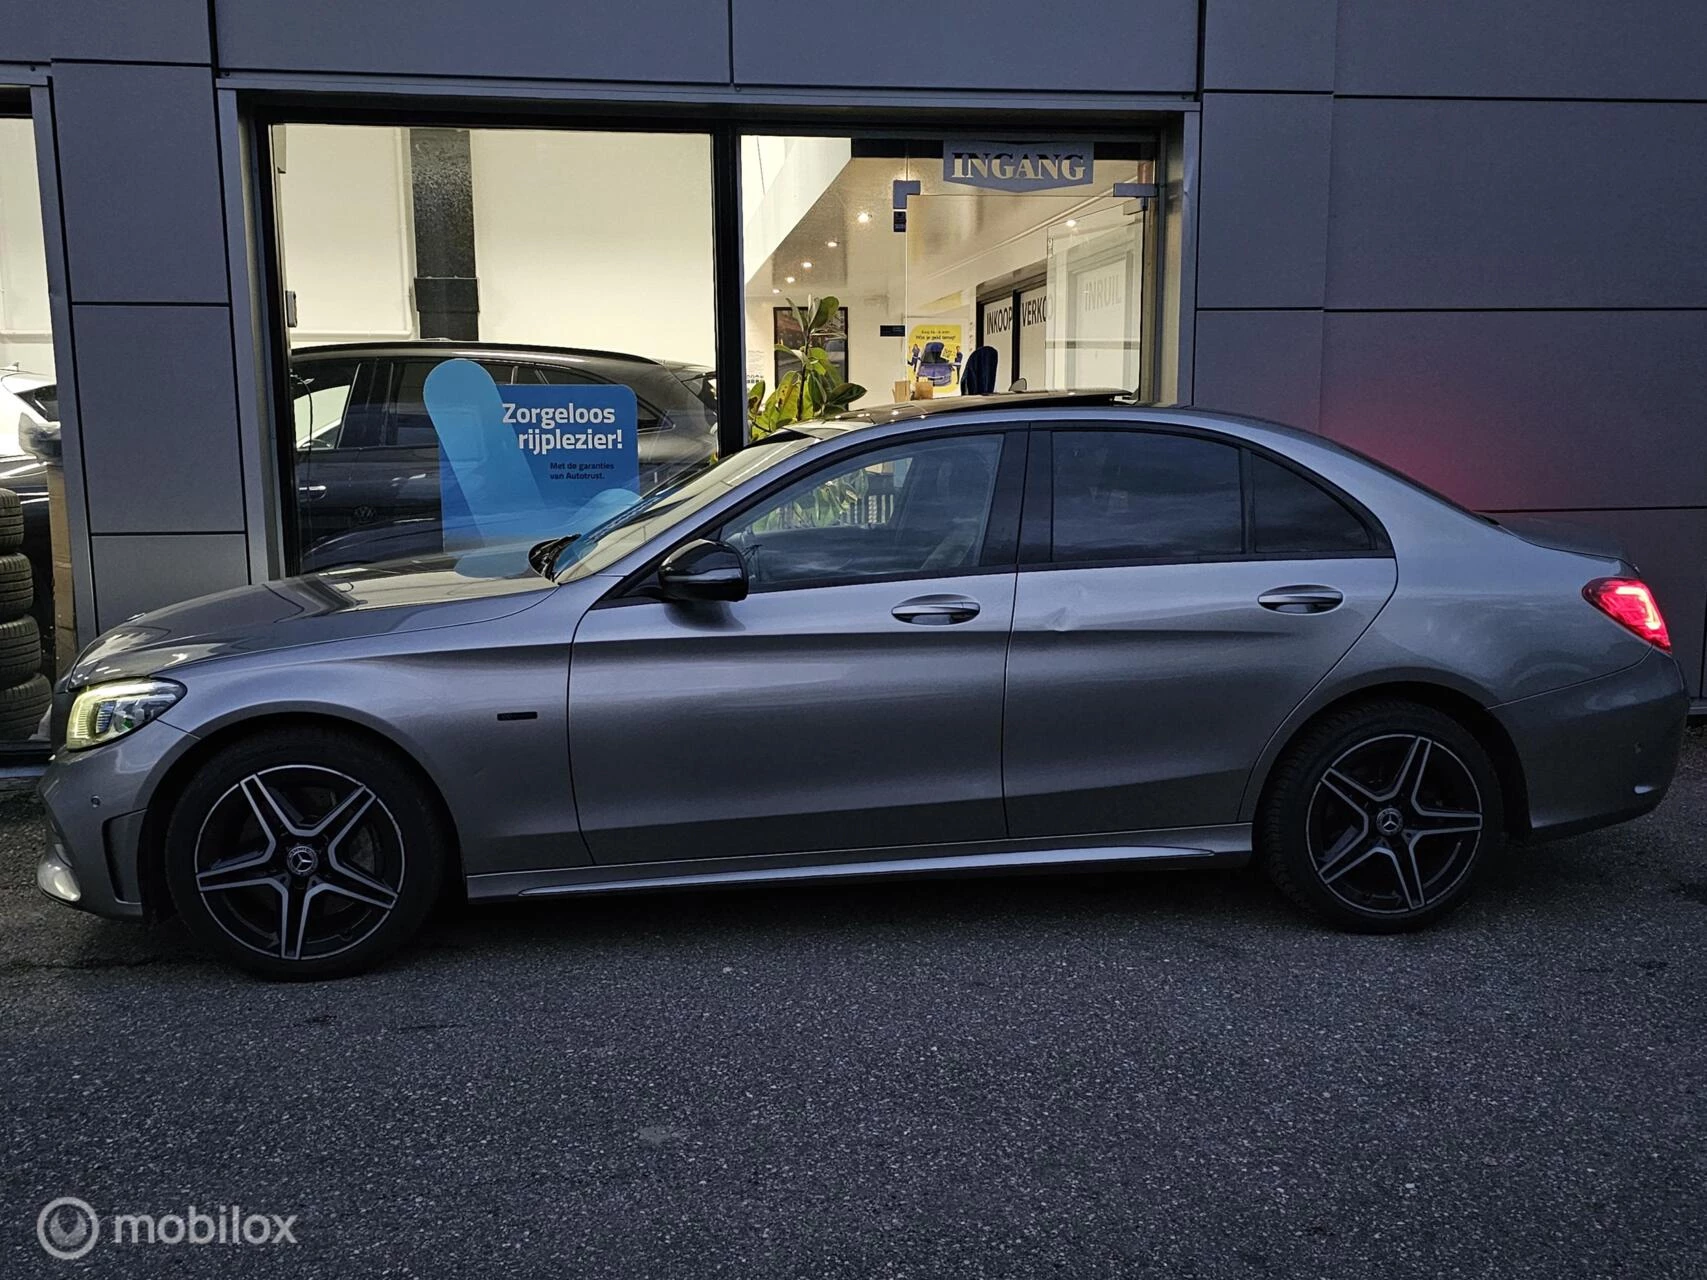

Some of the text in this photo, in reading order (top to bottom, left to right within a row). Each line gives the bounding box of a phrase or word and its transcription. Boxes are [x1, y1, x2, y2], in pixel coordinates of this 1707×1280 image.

[951, 152, 1085, 180] INGANG
[986, 306, 1013, 335] INKOOP
[502, 402, 616, 429] Zorgeloos
[518, 428, 623, 455] rijplezier!
[550, 462, 615, 472] Met de garanties
[566, 472, 605, 481] Autotrust.
